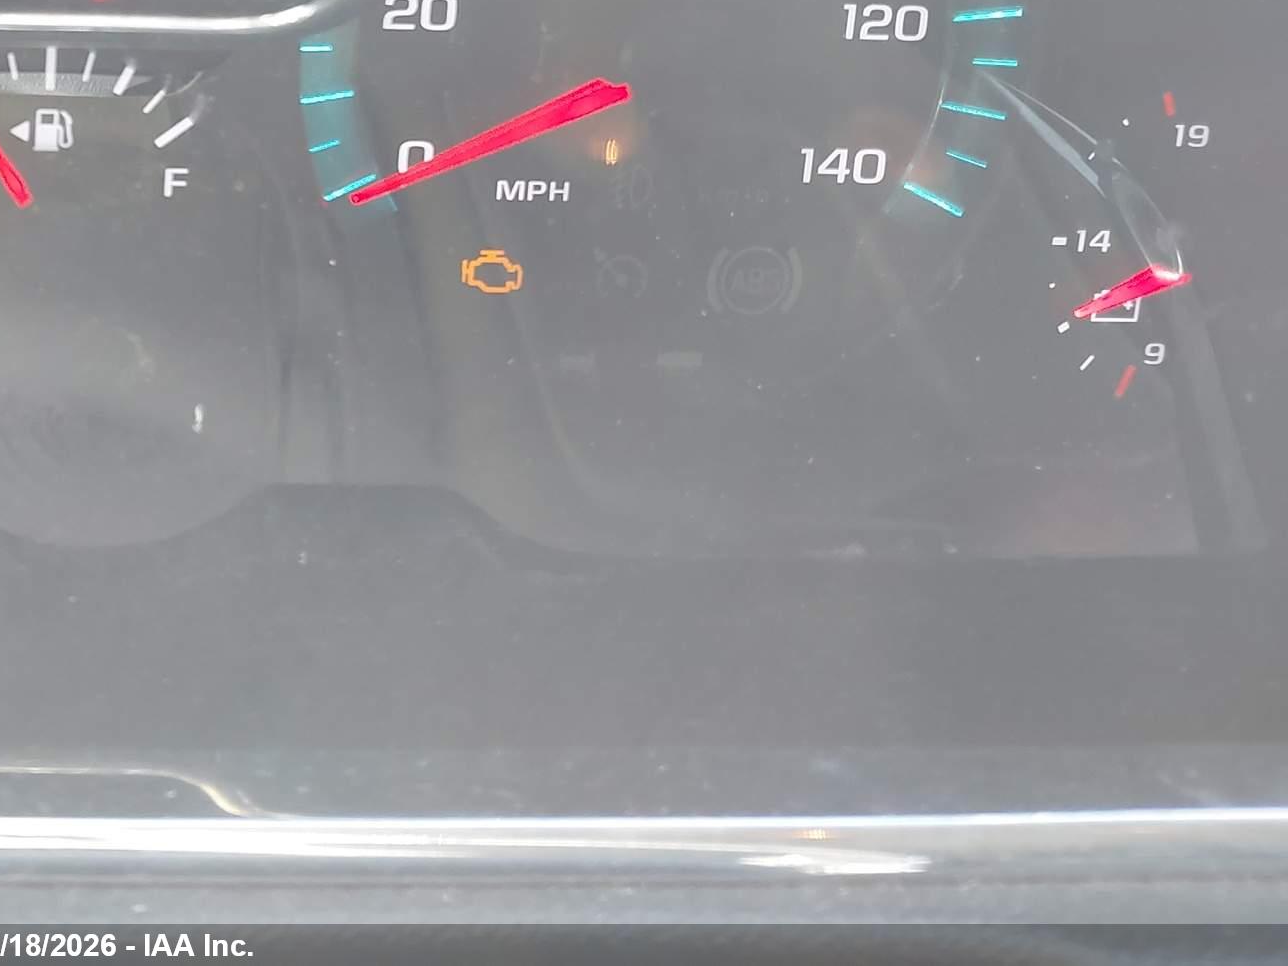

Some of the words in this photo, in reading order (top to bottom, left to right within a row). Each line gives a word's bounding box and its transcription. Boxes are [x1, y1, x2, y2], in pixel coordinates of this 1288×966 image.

[842, 3, 930, 43] 120
[1174, 123, 1211, 148] 19
[397, 140, 435, 176] 0
[799, 146, 888, 186] 140
[163, 167, 189, 198] F
[495, 178, 571, 203] MPH
[1075, 229, 1112, 253] 14
[1143, 342, 1167, 365] 9
